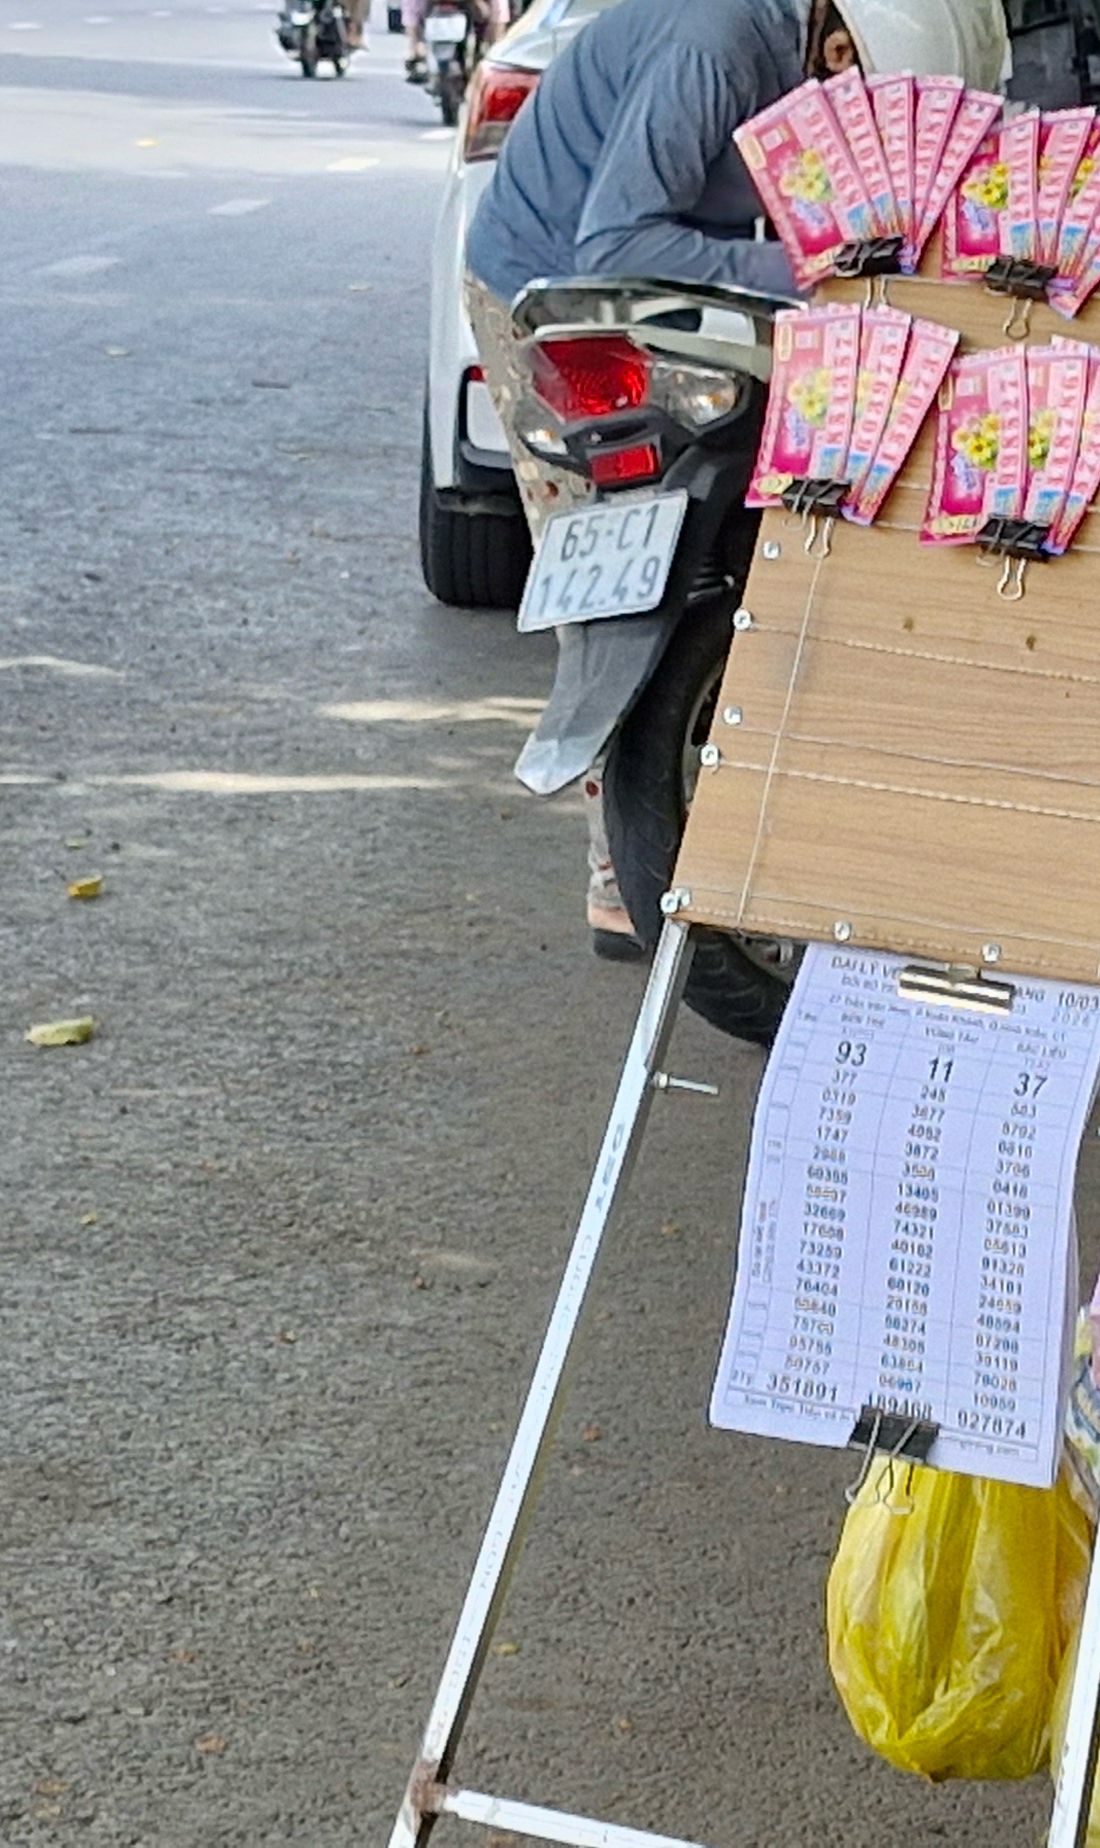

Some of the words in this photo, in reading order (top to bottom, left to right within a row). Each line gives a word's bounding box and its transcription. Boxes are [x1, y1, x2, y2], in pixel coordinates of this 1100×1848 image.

[561, 503, 660, 561] 65-C1
[1057, 991, 1100, 1013] 10/03
[835, 1041, 868, 1067] 93
[930, 1057, 954, 1083] 11
[1013, 1072, 1049, 1098] 37
